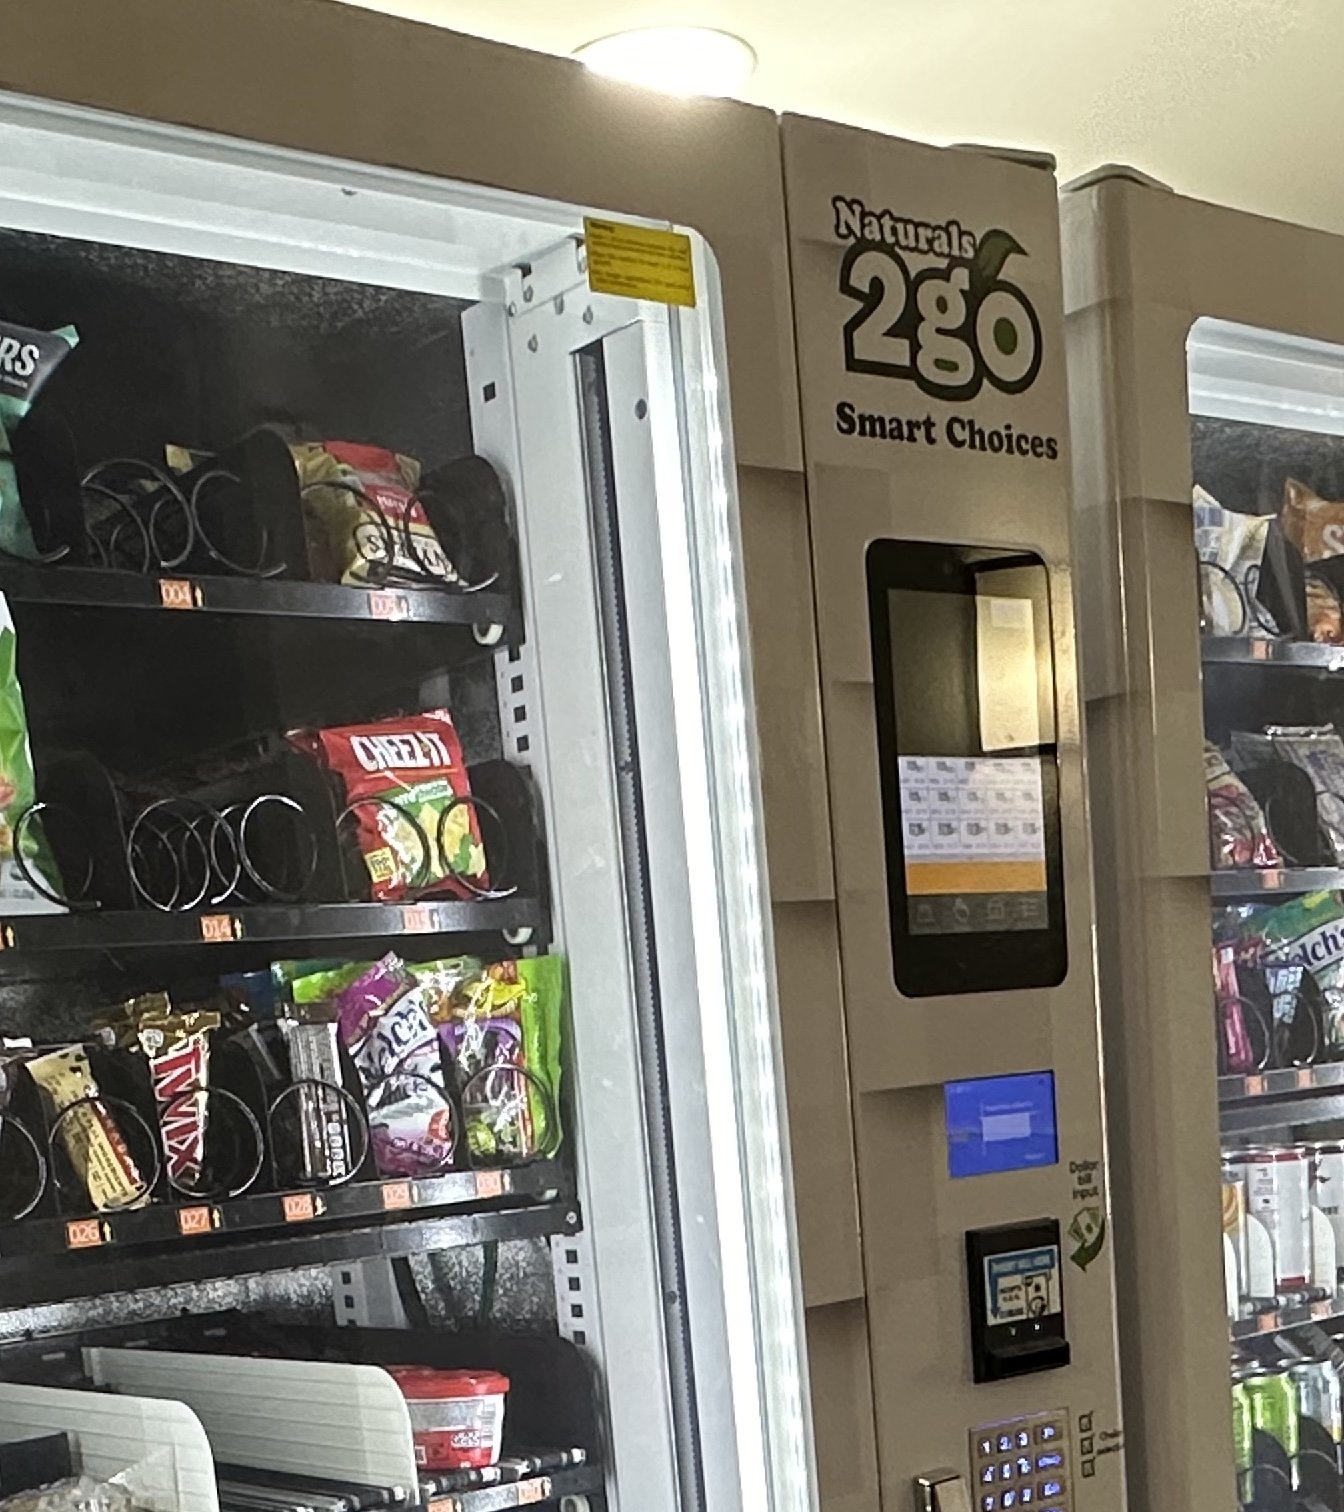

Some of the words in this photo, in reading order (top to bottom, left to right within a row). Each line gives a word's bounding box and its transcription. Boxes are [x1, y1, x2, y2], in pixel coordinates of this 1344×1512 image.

[831, 195, 977, 260] Naturals
[839, 240, 1043, 402] 2go
[836, 401, 938, 445] Smart
[945, 415, 1058, 460] Choices
[161, 582, 192, 605] 004
[203, 920, 231, 937] 014
[150, 1044, 208, 1179] TWIX
[71, 1223, 100, 1244] 026
[181, 1209, 209, 1229] 027
